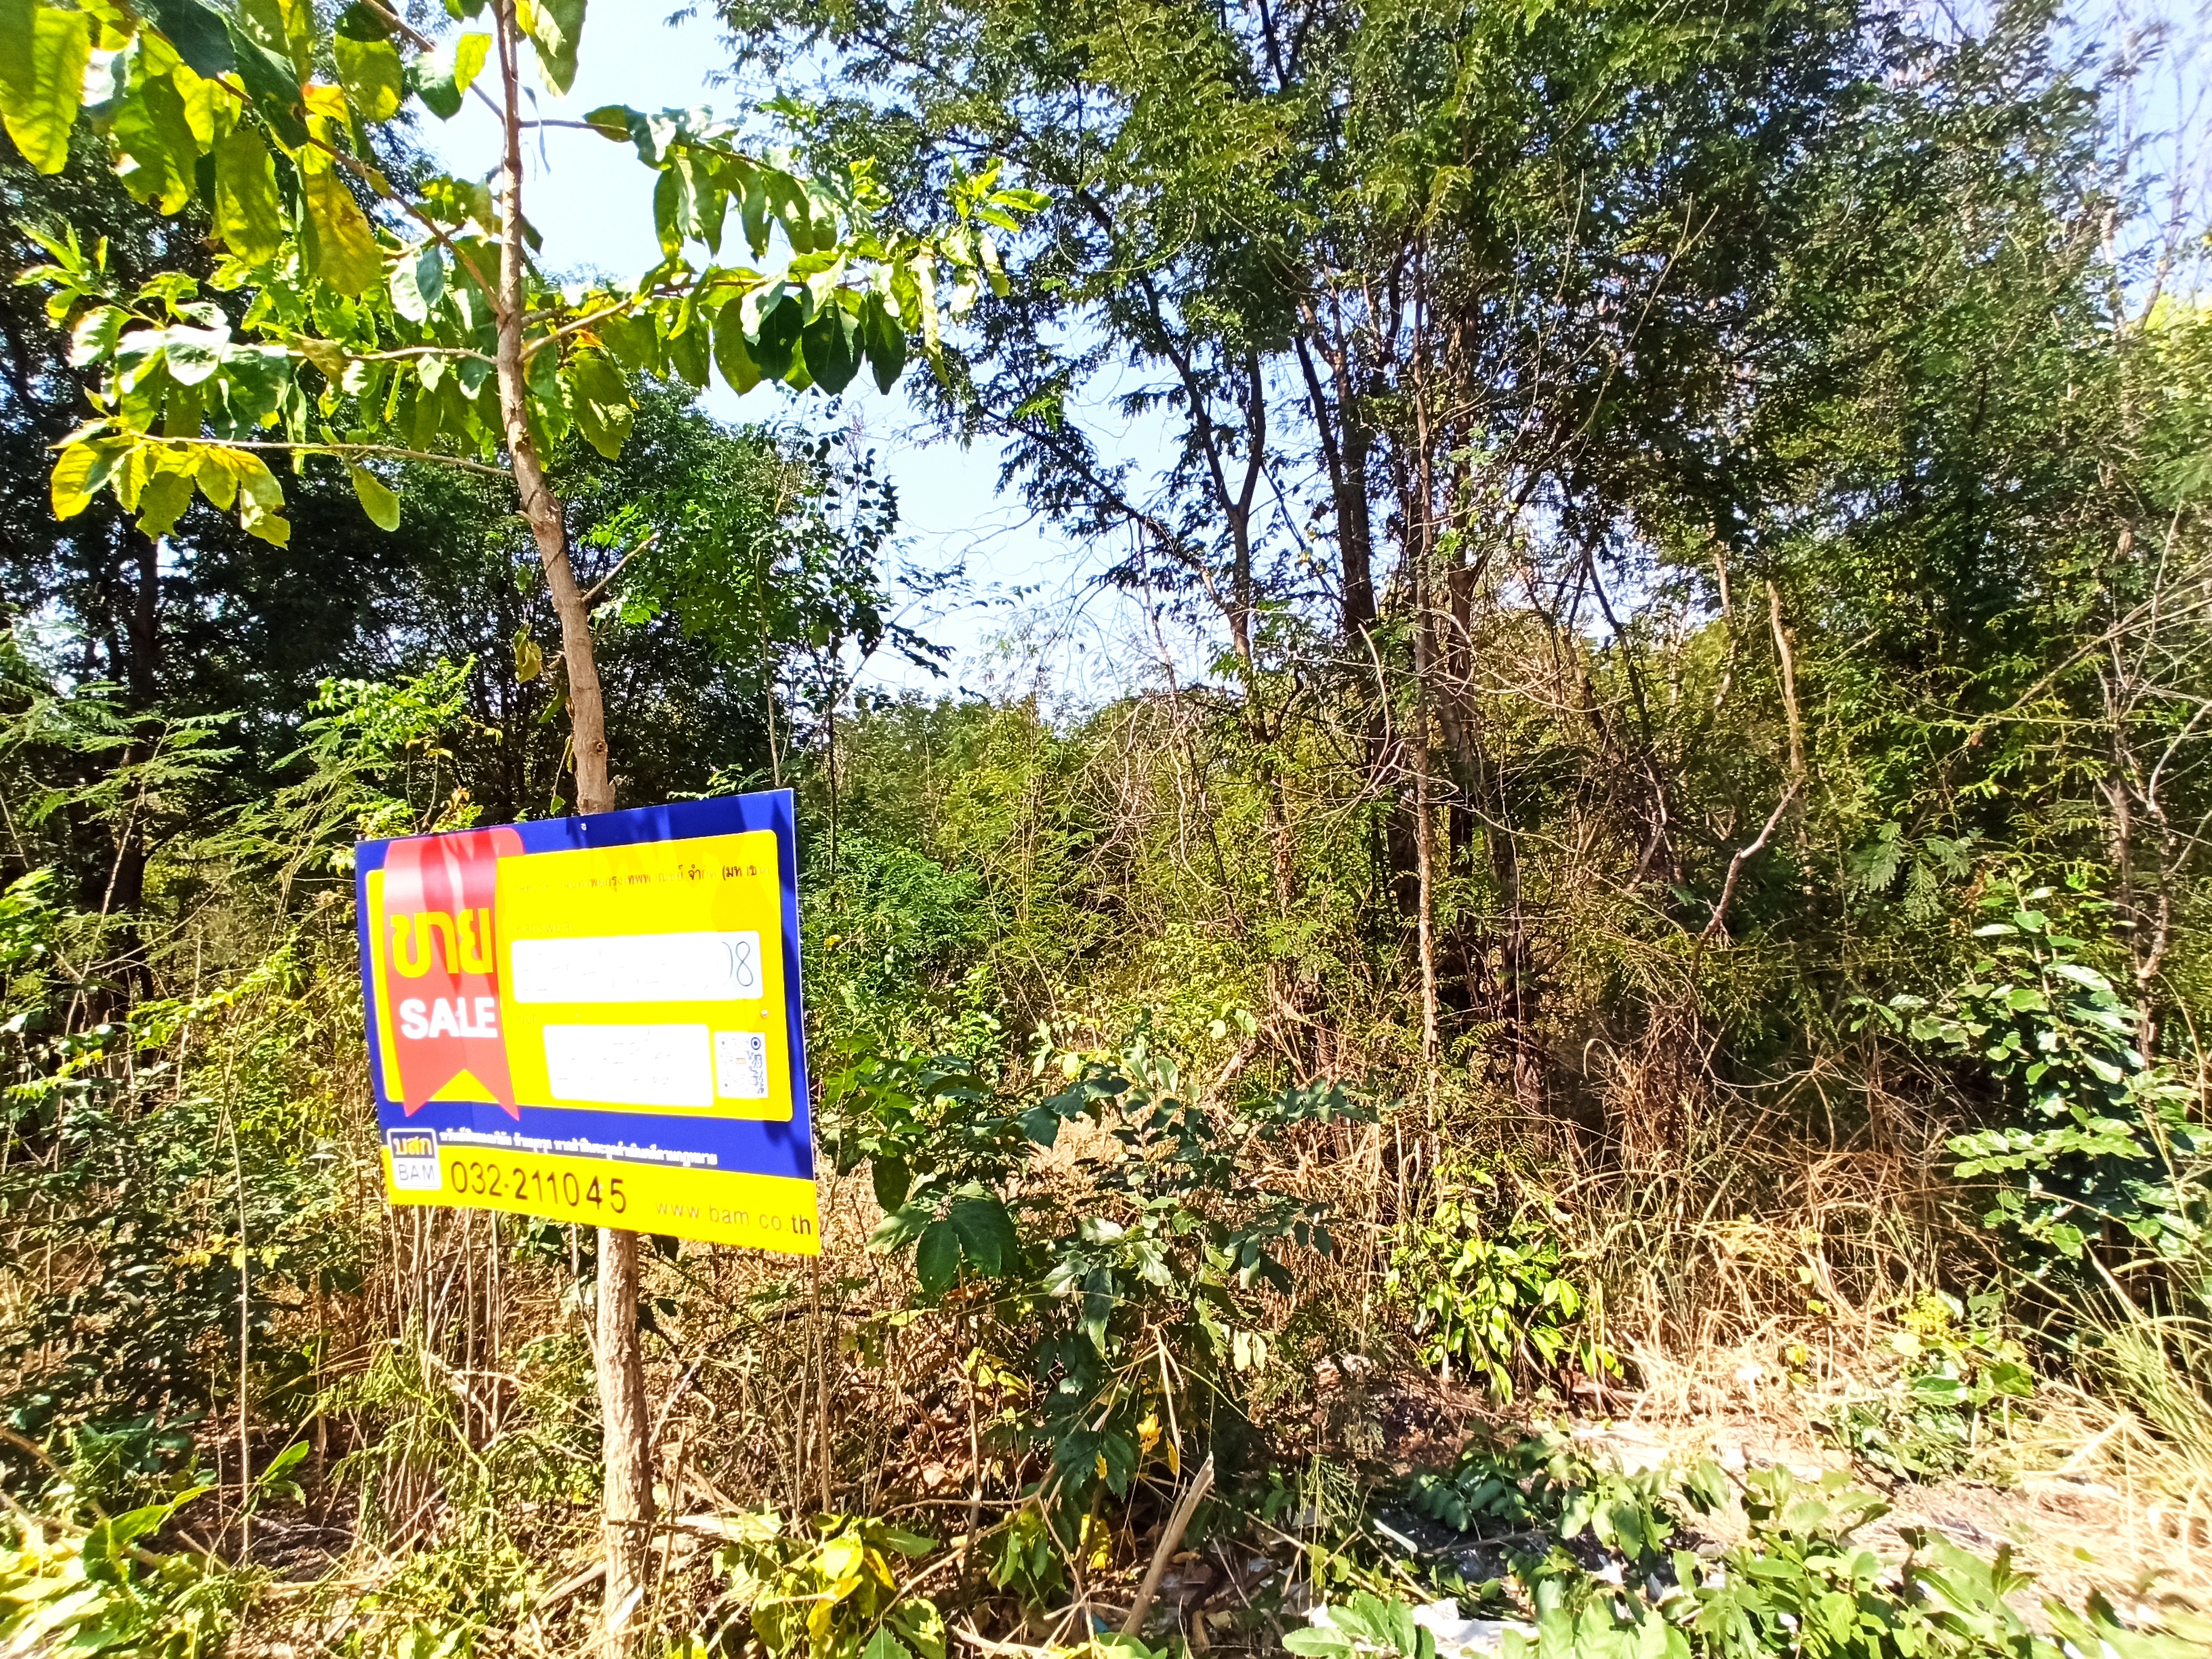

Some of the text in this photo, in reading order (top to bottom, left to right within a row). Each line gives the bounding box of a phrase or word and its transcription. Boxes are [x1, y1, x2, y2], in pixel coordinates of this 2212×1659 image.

[390, 907, 493, 978] ขาย
[399, 997, 497, 1040] SALE
[393, 1136, 432, 1155] บสก
[398, 1164, 434, 1181] BAM
[656, 1203, 811, 1235] wwwbam.co.th
